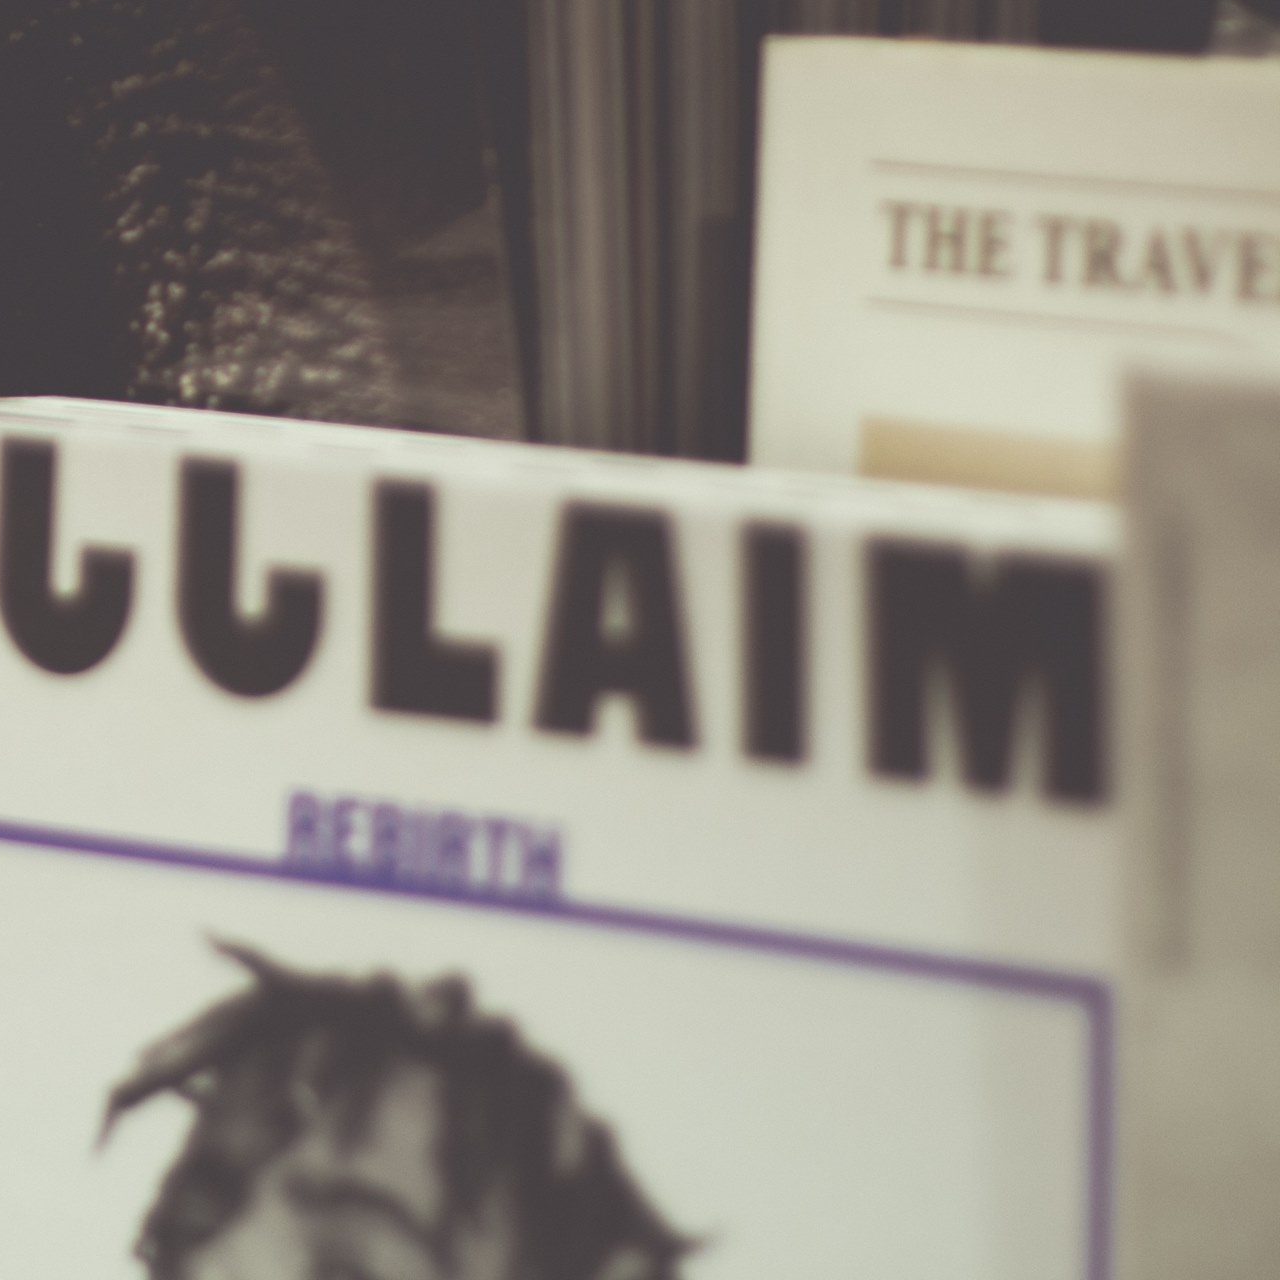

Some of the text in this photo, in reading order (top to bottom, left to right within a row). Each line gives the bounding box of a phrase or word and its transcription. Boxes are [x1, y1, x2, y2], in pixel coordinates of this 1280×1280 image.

[878, 199, 1280, 310] THE TRAVE
[283, 788, 567, 905] REBIRTH
